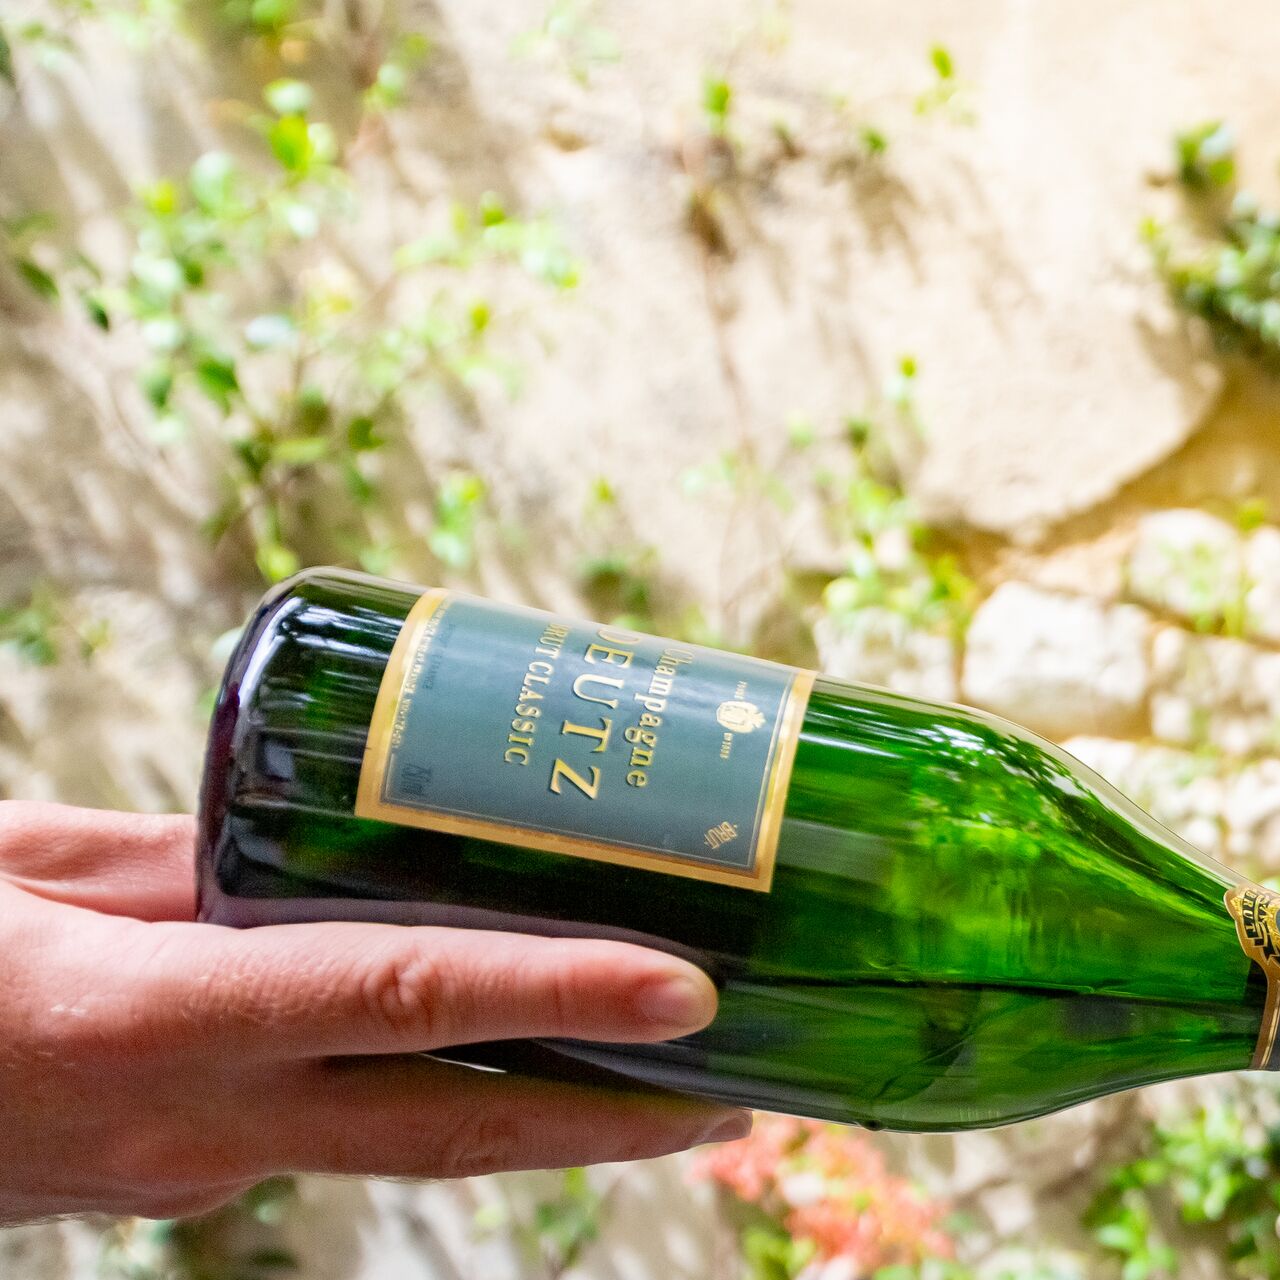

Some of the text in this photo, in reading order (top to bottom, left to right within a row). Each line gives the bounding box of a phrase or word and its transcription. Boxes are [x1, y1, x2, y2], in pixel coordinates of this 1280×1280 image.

[504, 623, 570, 766] BRUT CLASSIC
[550, 627, 642, 800] DEUTZ
[624, 648, 695, 787] Champagne
[1242, 889, 1258, 934] BRUT
